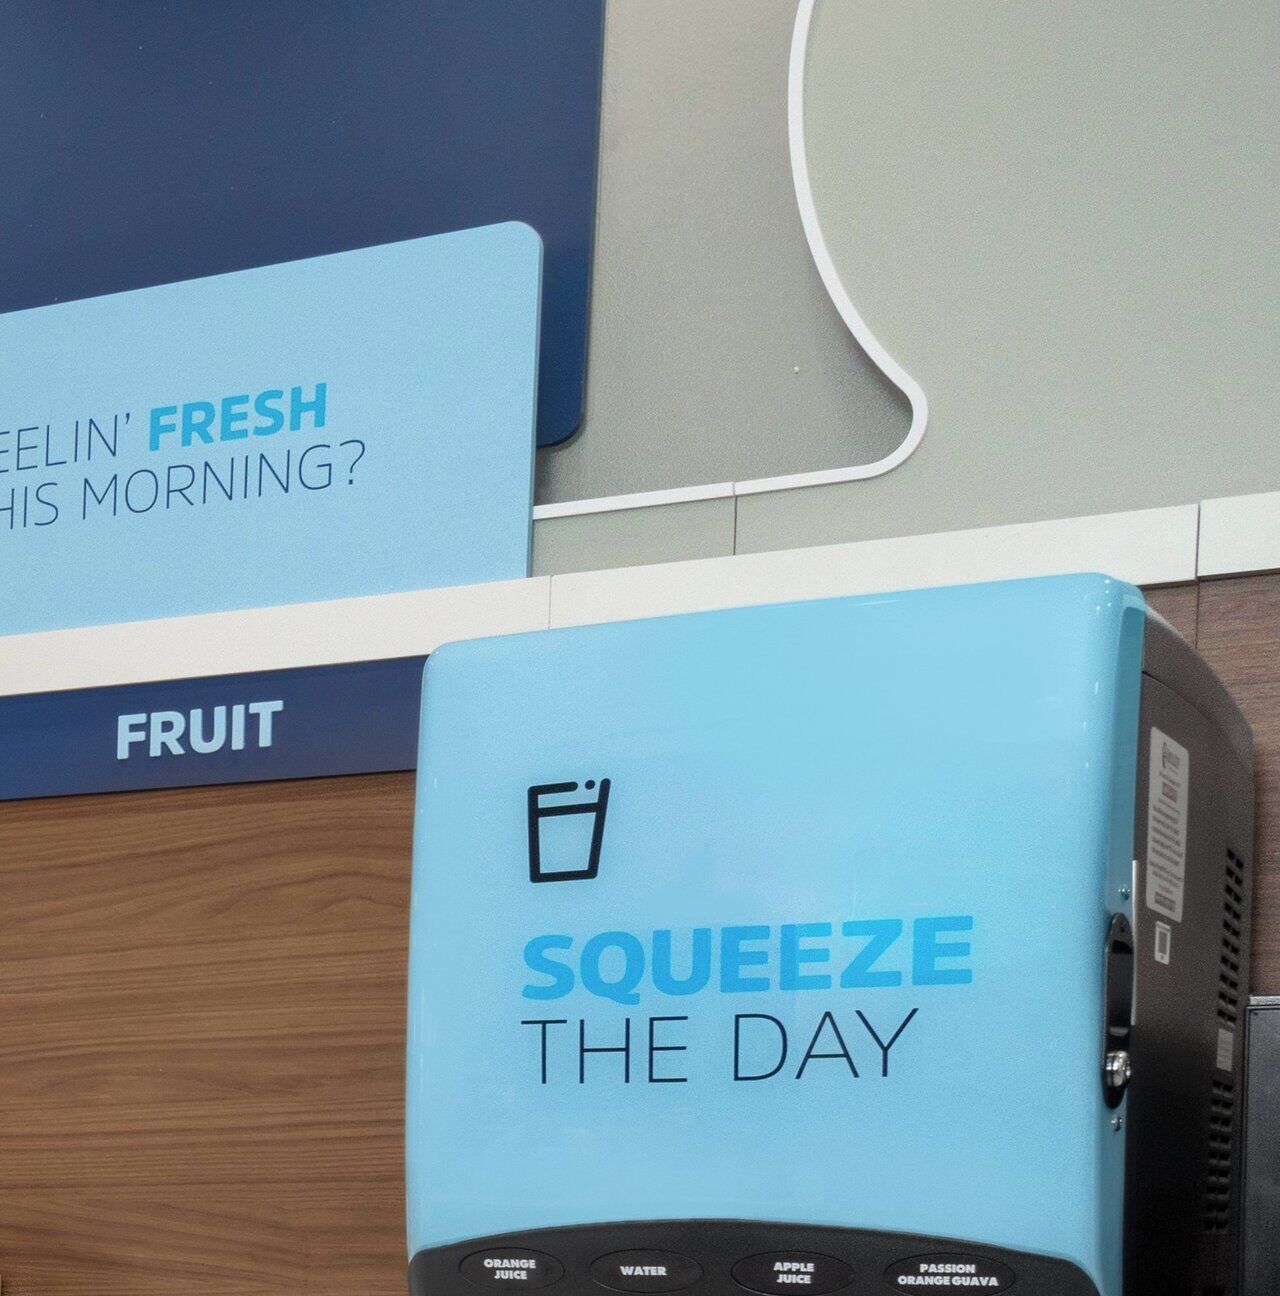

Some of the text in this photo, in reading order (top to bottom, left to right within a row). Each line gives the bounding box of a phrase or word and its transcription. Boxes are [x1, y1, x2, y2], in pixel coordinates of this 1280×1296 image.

[148, 382, 328, 451] FRESH
[82, 439, 367, 520] MORNING?
[116, 700, 285, 760] FRUIT
[521, 914, 974, 1005] SQUEEZE
[520, 1008, 920, 1085] THE DAY
[483, 1258, 537, 1269] ORANGE
[773, 1261, 816, 1273] APPLE
[919, 1263, 976, 1274] PASSION
[494, 1270, 528, 1280] JUICE
[619, 1265, 668, 1276] WATER
[776, 1274, 812, 1285] JUICE
[897, 1275, 1000, 1287] ORANGE GUAVA
